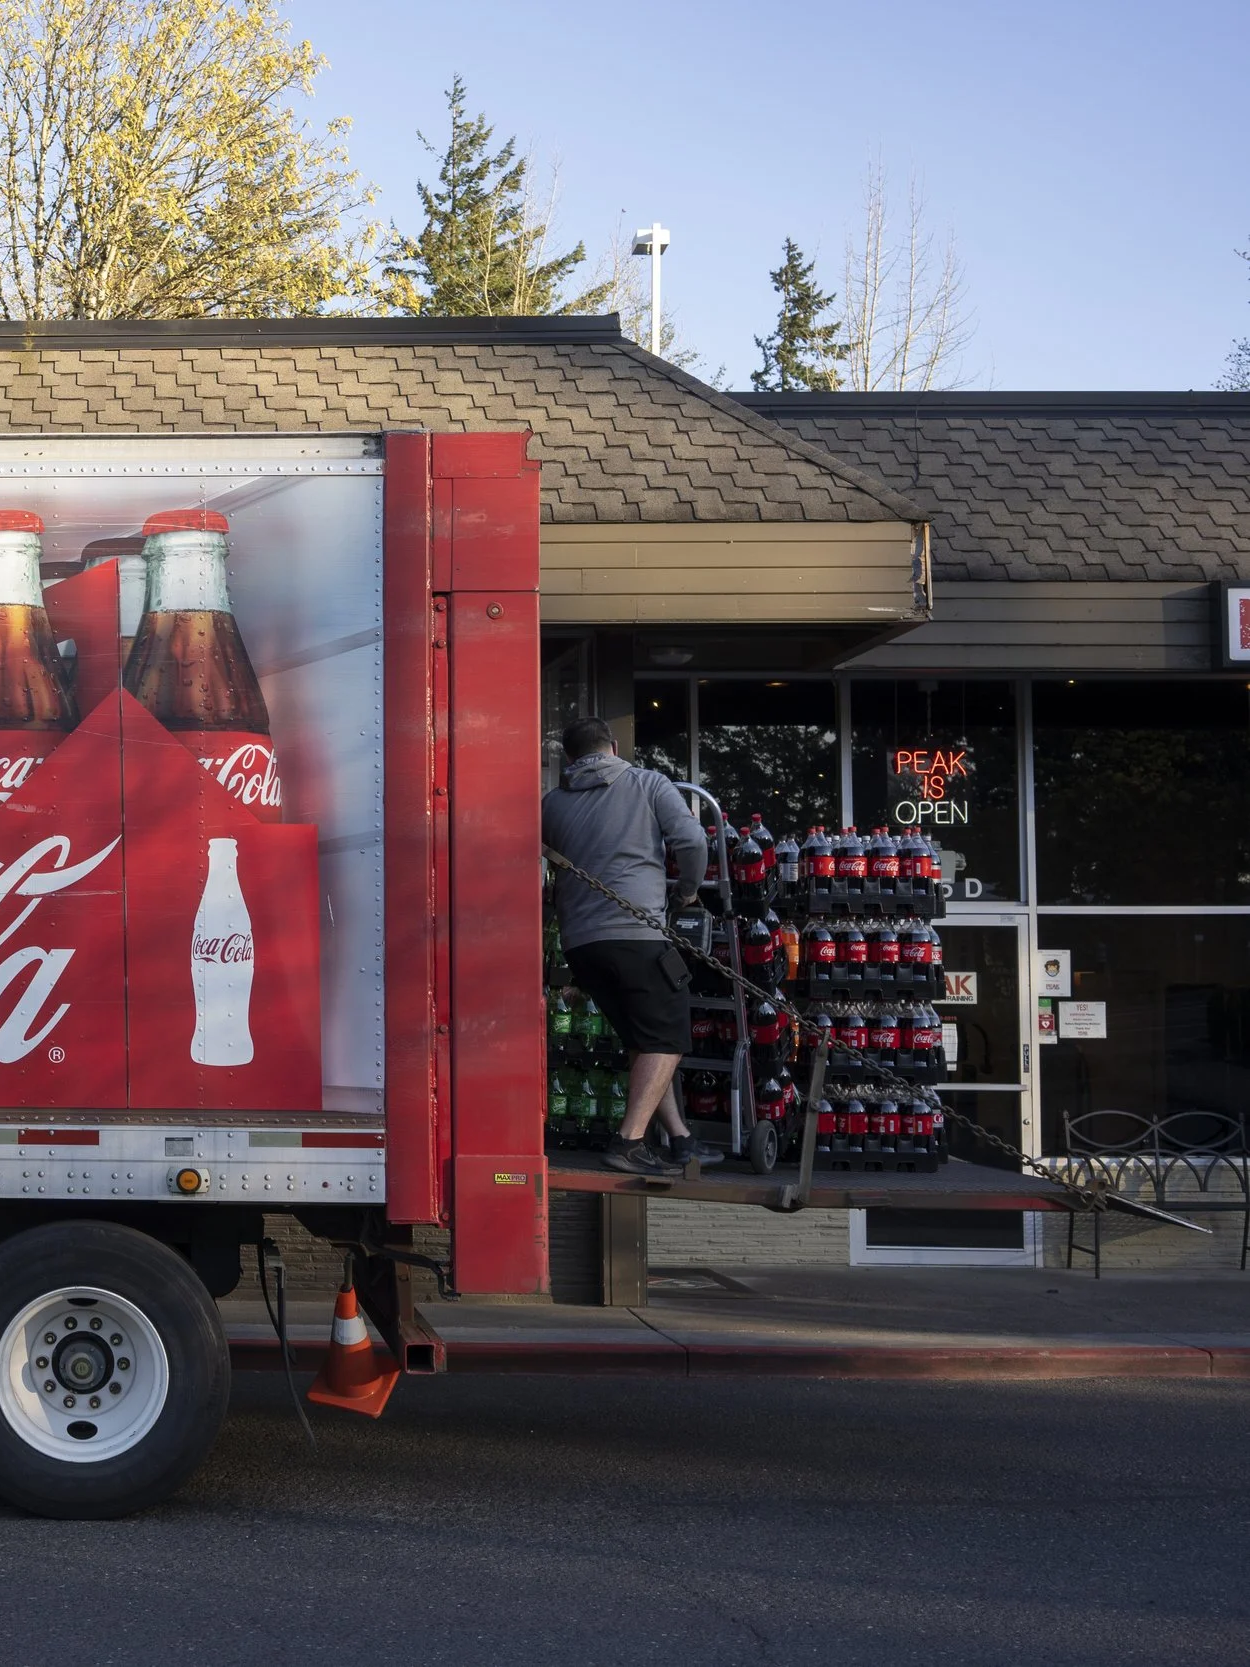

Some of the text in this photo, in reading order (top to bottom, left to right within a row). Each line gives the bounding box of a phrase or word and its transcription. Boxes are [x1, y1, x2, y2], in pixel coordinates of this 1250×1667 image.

[896, 751, 967, 776] PEAK
[924, 776, 945, 798] IS
[896, 801, 968, 824] OPEN
[965, 877, 983, 898] D
[193, 933, 252, 963] Coca-Cola
